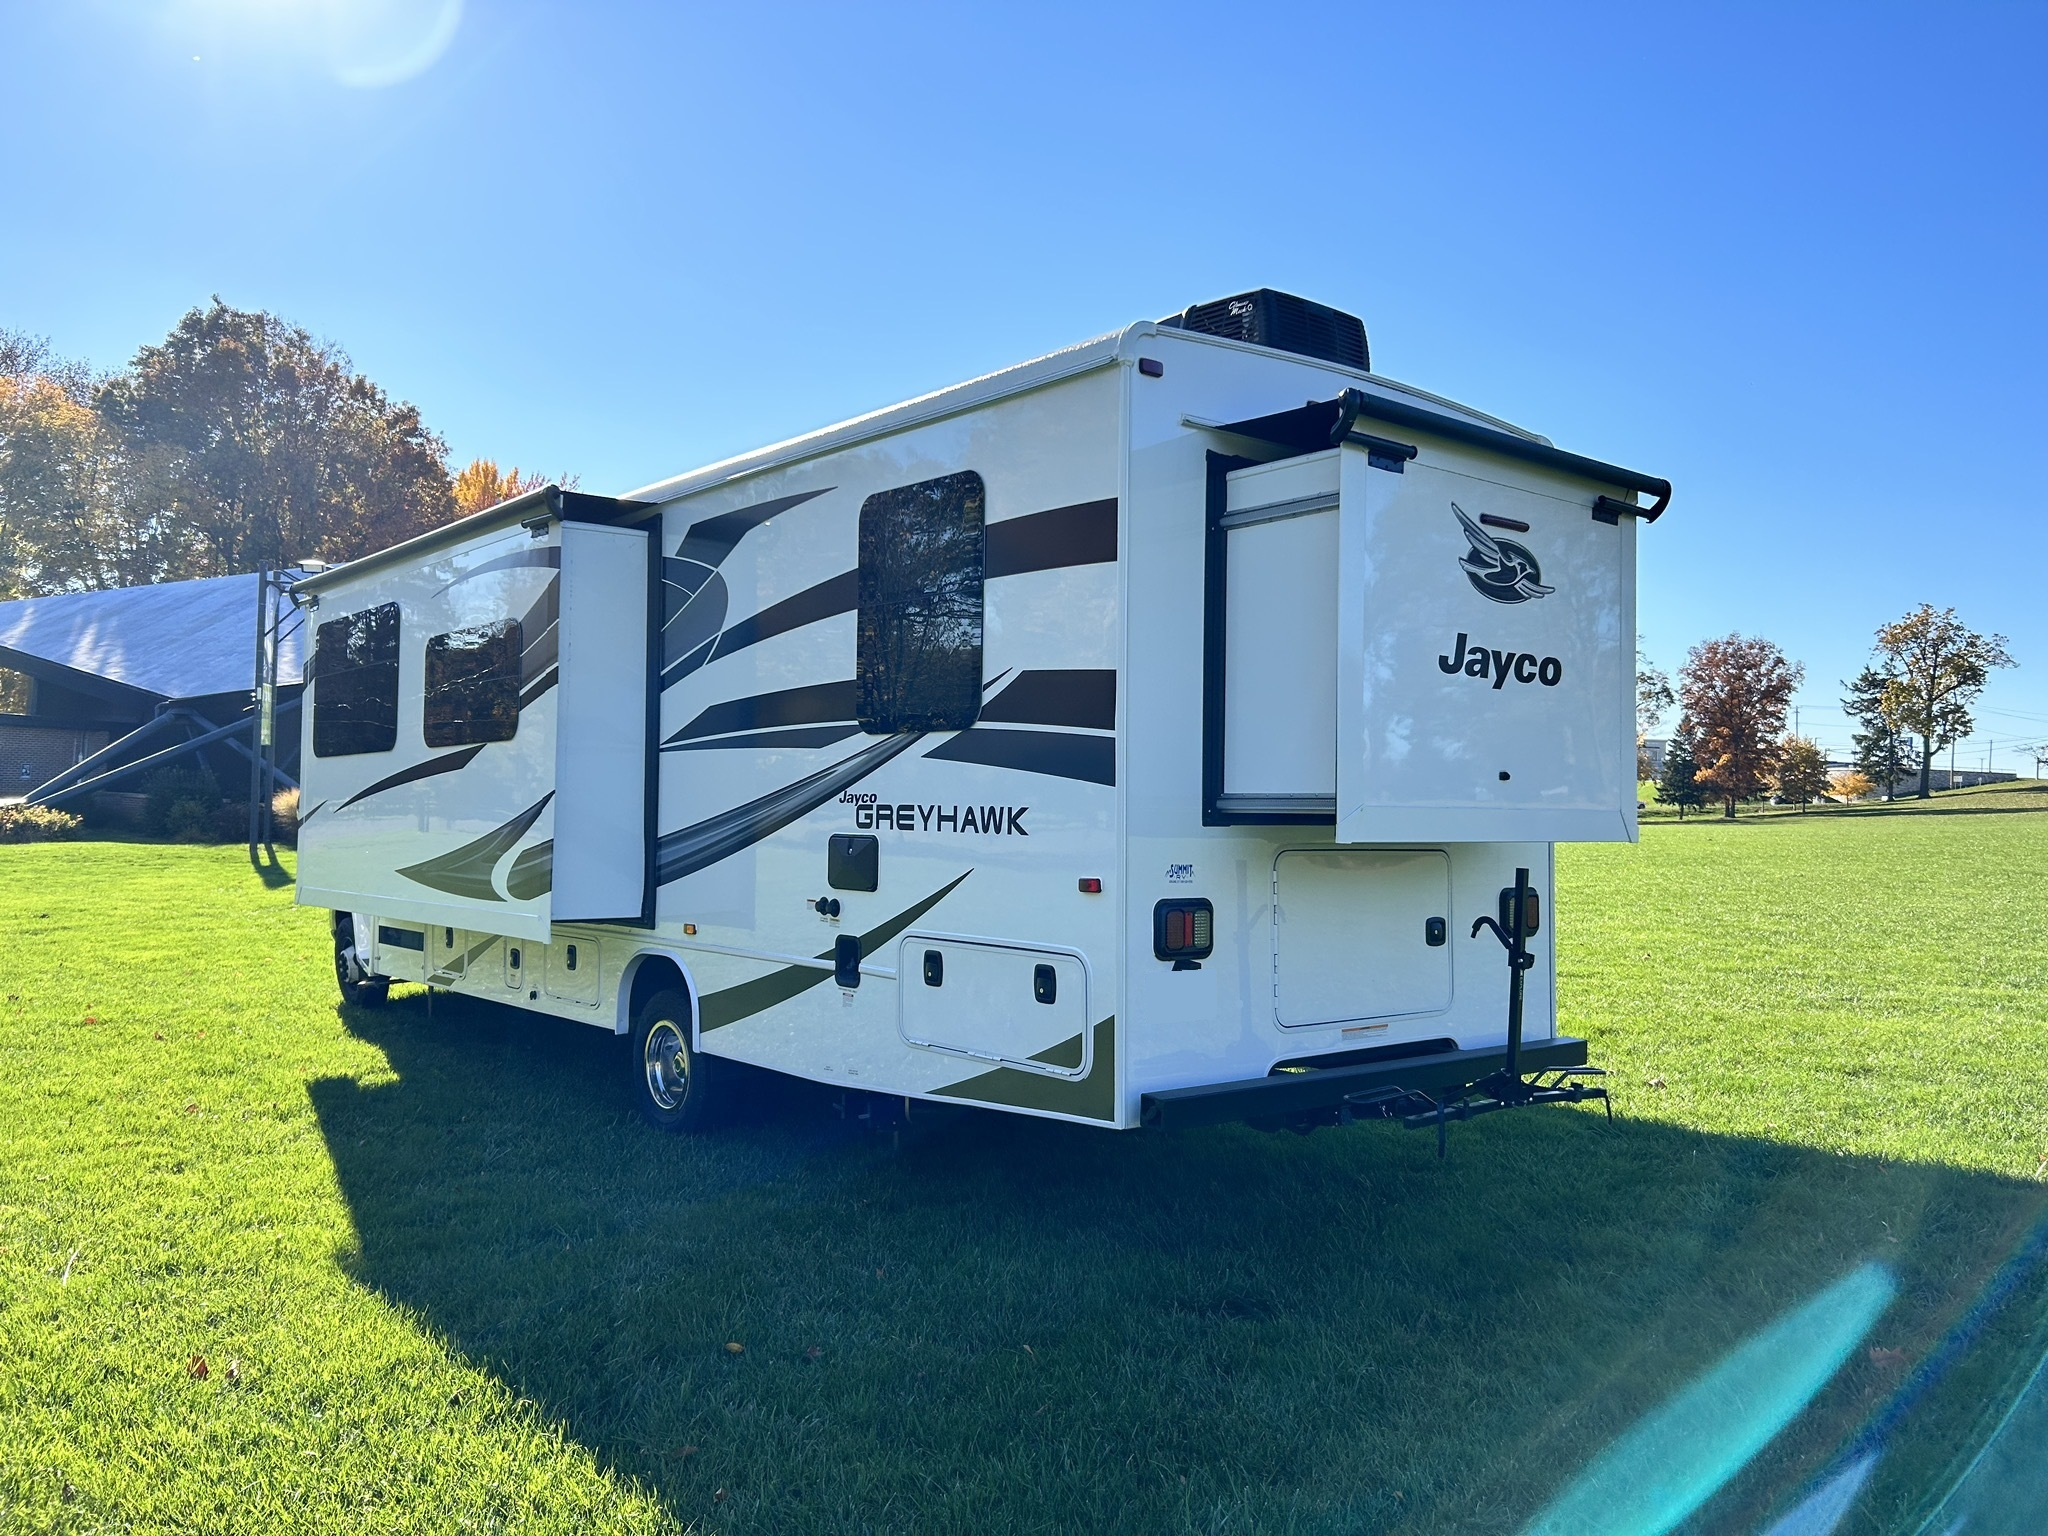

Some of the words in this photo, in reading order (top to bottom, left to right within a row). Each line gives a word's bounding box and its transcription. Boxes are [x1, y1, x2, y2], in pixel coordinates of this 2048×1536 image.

[1438, 632, 1562, 690] Jayco
[839, 790, 878, 806] Jayco
[855, 804, 1029, 836] GREYHAWK
[1169, 864, 1192, 877] SUMMIT
